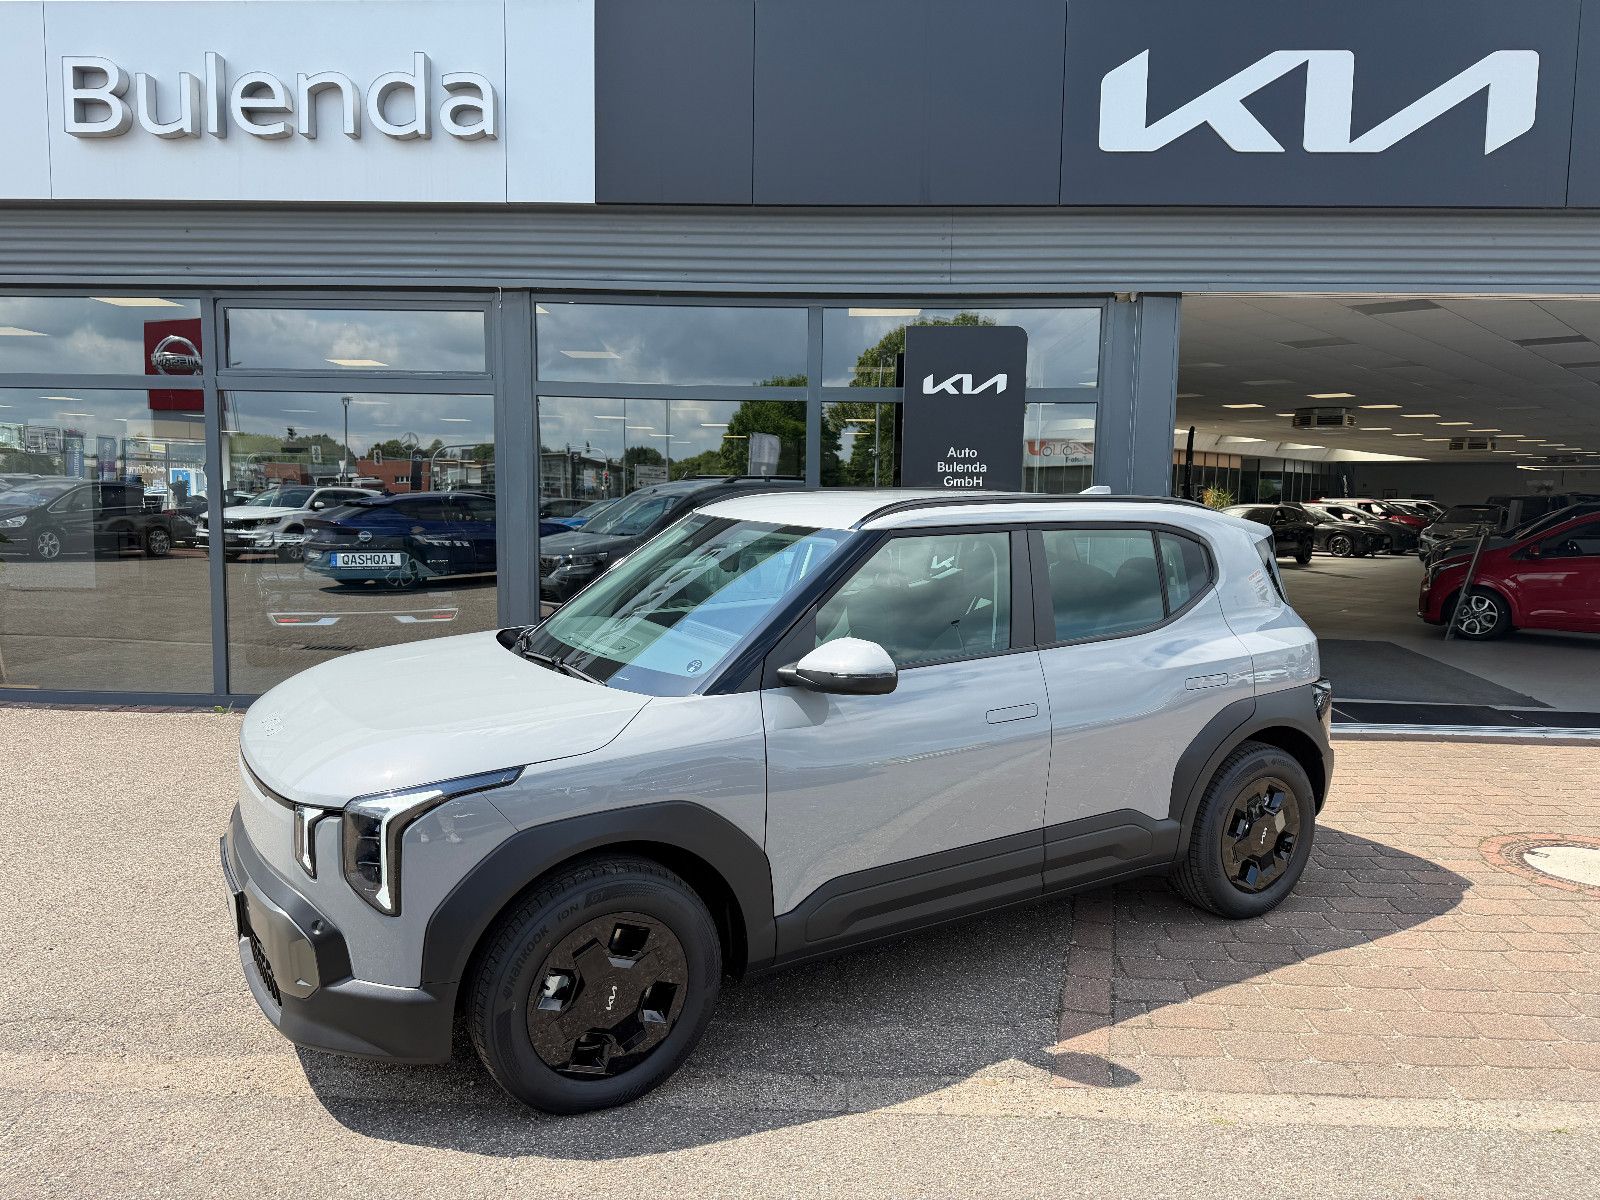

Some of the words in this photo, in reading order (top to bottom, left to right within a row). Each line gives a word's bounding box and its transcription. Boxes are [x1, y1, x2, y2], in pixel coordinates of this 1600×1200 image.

[61, 52, 499, 141] Bulenda
[1099, 49, 1539, 154] KIA
[922, 373, 1008, 395] KIA
[947, 446, 977, 458] Auto
[937, 461, 987, 473] Bulenda
[943, 475, 983, 487] GmbH
[342, 554, 396, 566] QASHQAI
